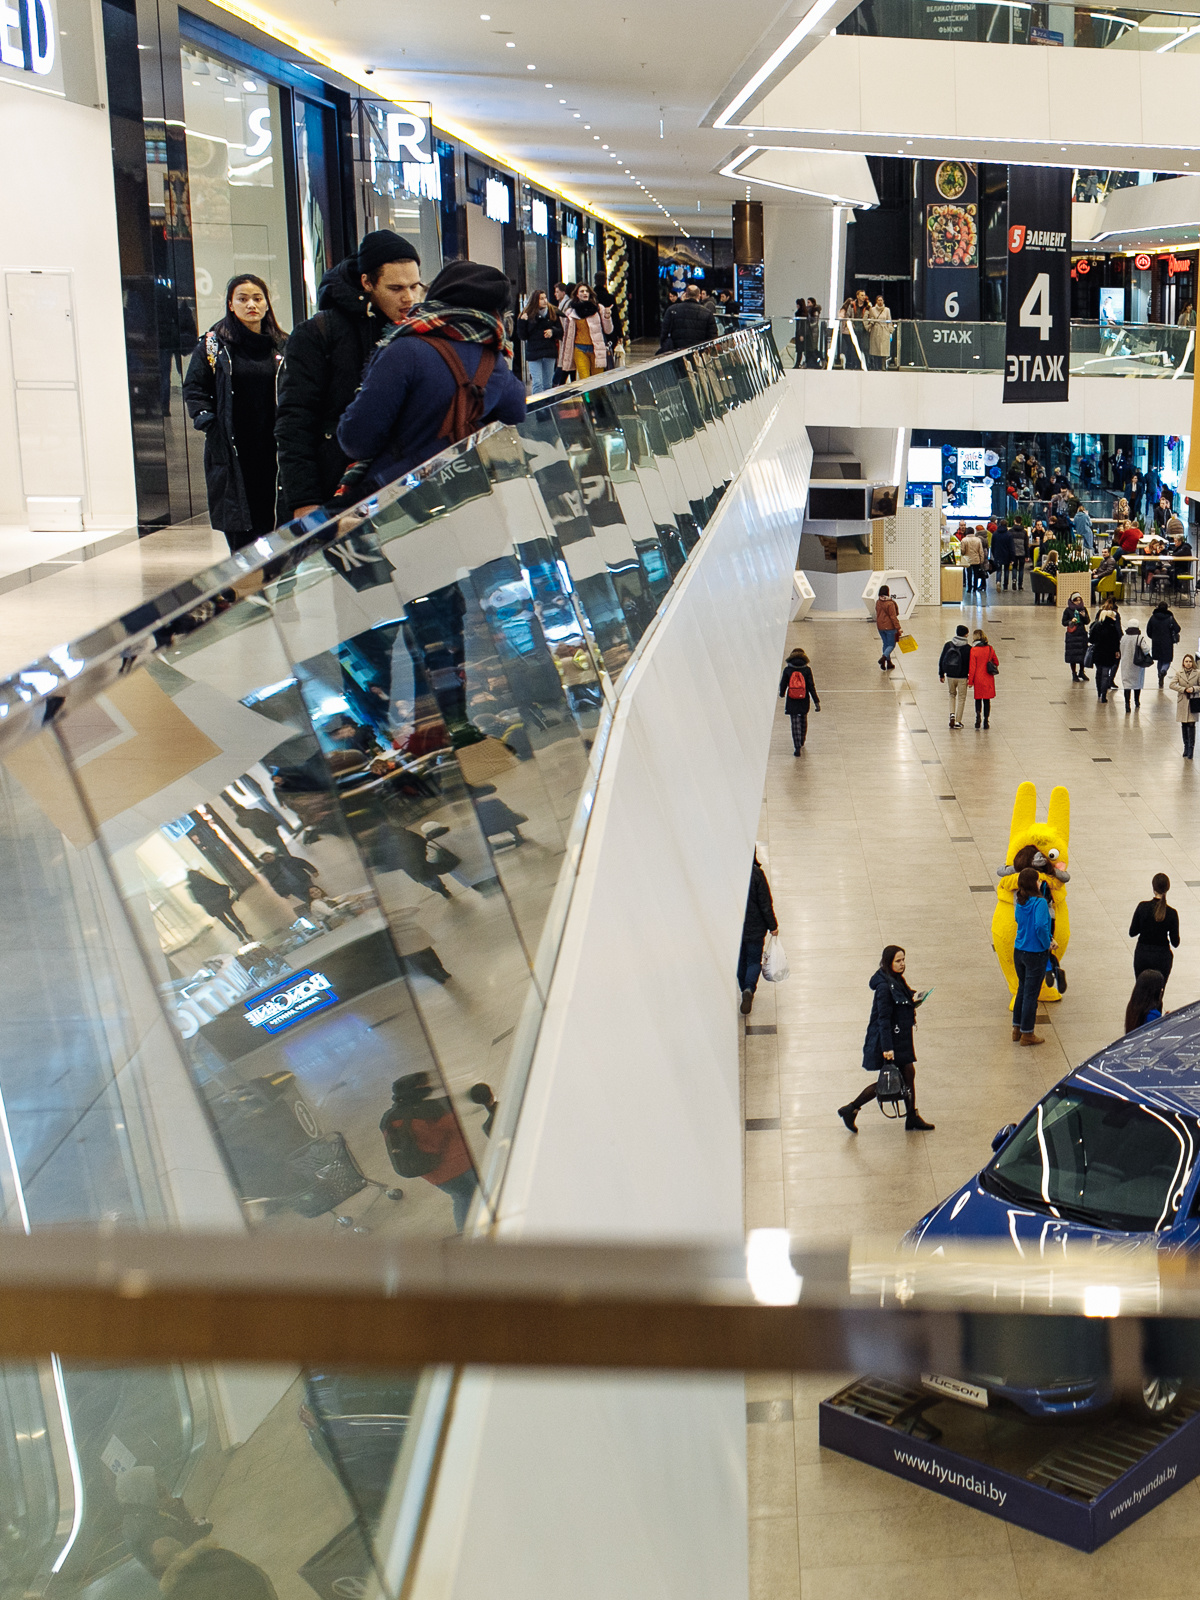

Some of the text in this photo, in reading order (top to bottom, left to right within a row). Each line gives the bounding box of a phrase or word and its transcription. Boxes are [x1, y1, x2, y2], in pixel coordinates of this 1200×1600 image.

[1011, 229, 1067, 248] 5 ЭЛЕМЕНТ
[944, 291, 960, 318] 6
[1019, 273, 1053, 341] 4
[932, 329, 972, 344] ЭТАЖ
[1006, 355, 1065, 383] ЭТАЖ
[963, 460, 979, 470] SALE
[928, 1374, 980, 1398] TUCSON
[894, 1449, 1007, 1506] www.hyundai.by
[1110, 1464, 1178, 1520] www.hyundai.by
